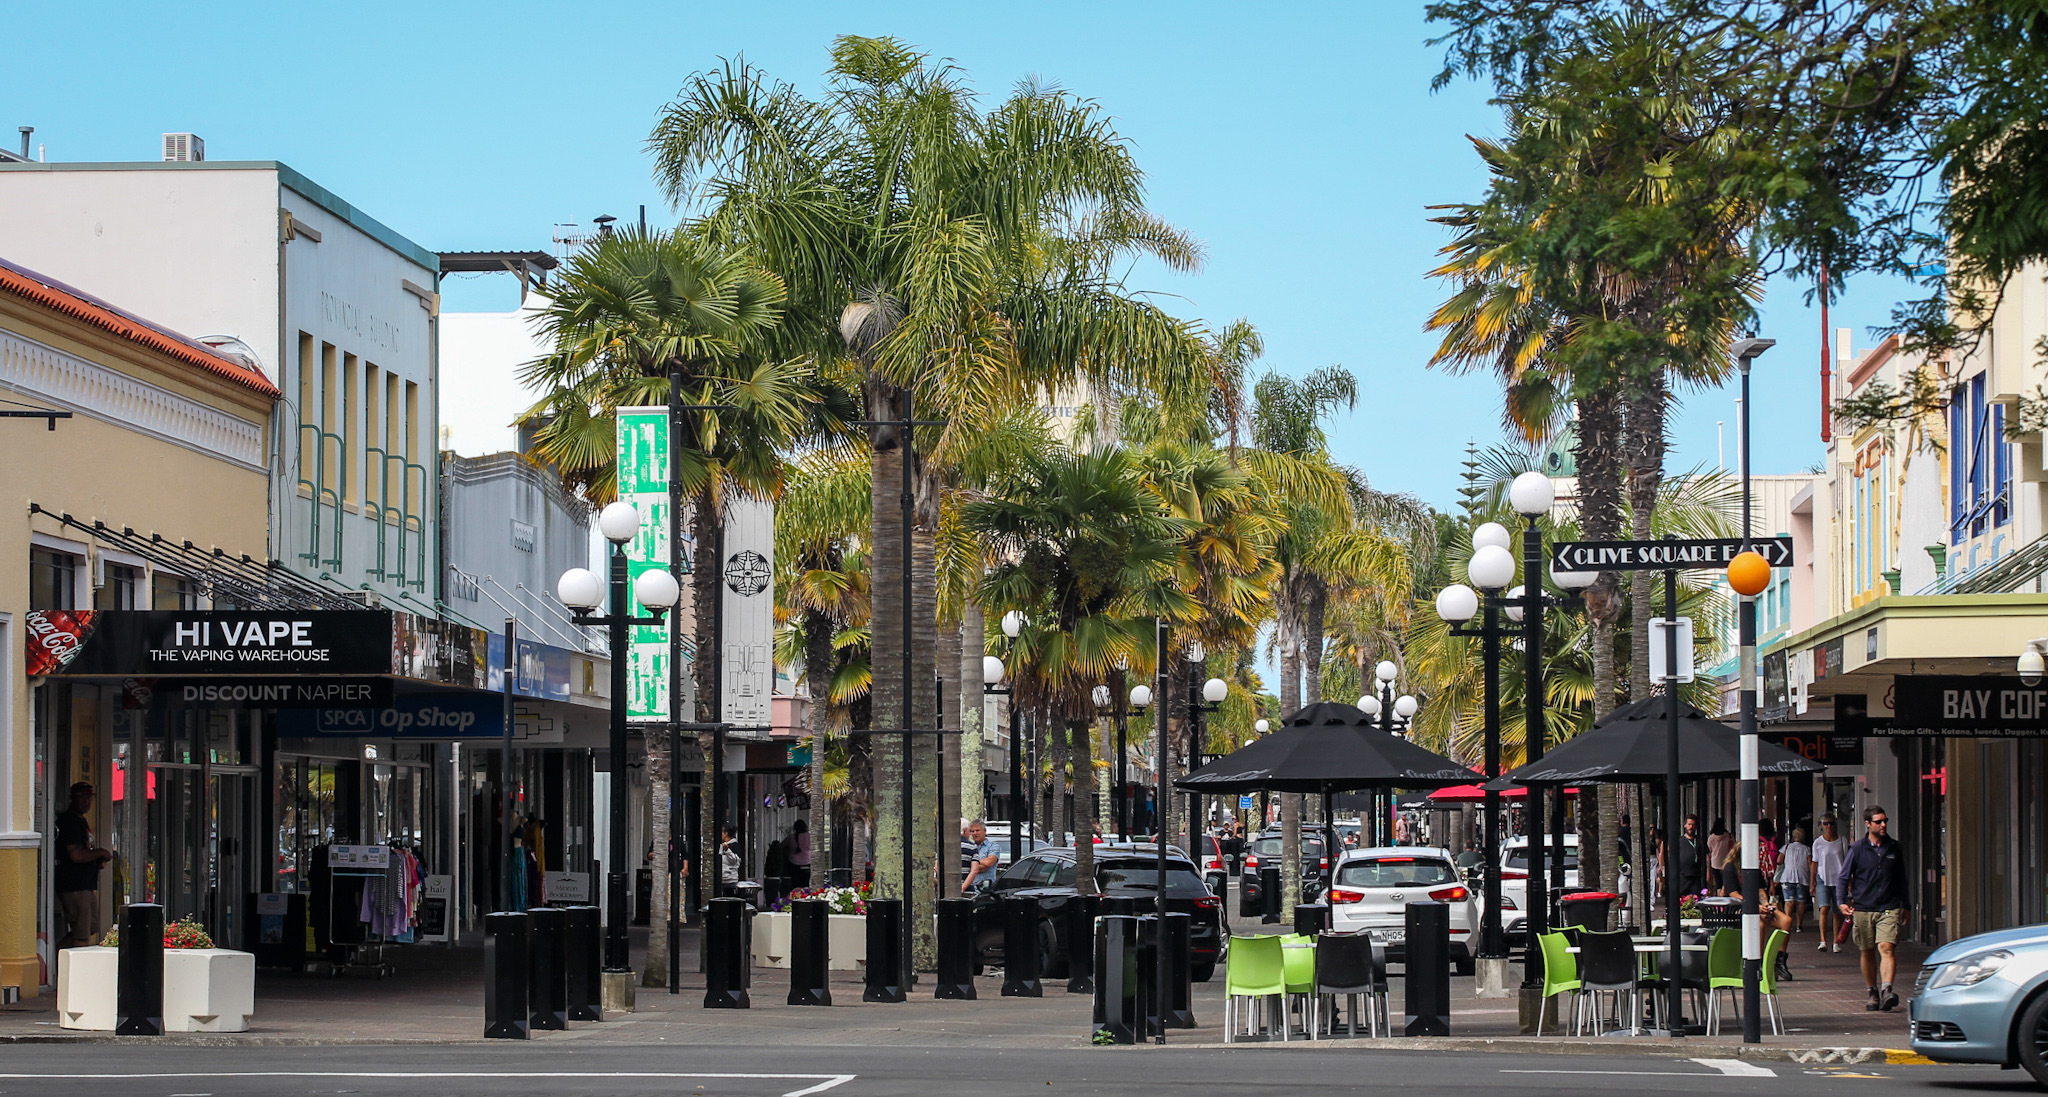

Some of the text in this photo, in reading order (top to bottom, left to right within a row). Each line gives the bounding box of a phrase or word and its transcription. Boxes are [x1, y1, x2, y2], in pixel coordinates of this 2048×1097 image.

[1574, 544, 1773, 566] CLIVE SQUARE EST
[26, 610, 83, 666] oca-Cola
[175, 621, 313, 647] HI VAPE
[150, 650, 330, 661] THE VAPING WAREHOUSE
[183, 684, 372, 701] DISCOUNT NAPIER
[1943, 690, 2047, 719] BAY COF
[324, 709, 366, 725] SPCA
[380, 706, 475, 732] Op Shop
[1887, 728, 1915, 736] Unique
[1941, 728, 1973, 737] Katana,
[1974, 728, 2003, 737] Swords,
[2004, 728, 2039, 737] Daggers,
[1784, 735, 1827, 760] Deli
[430, 885, 446, 894] hair
